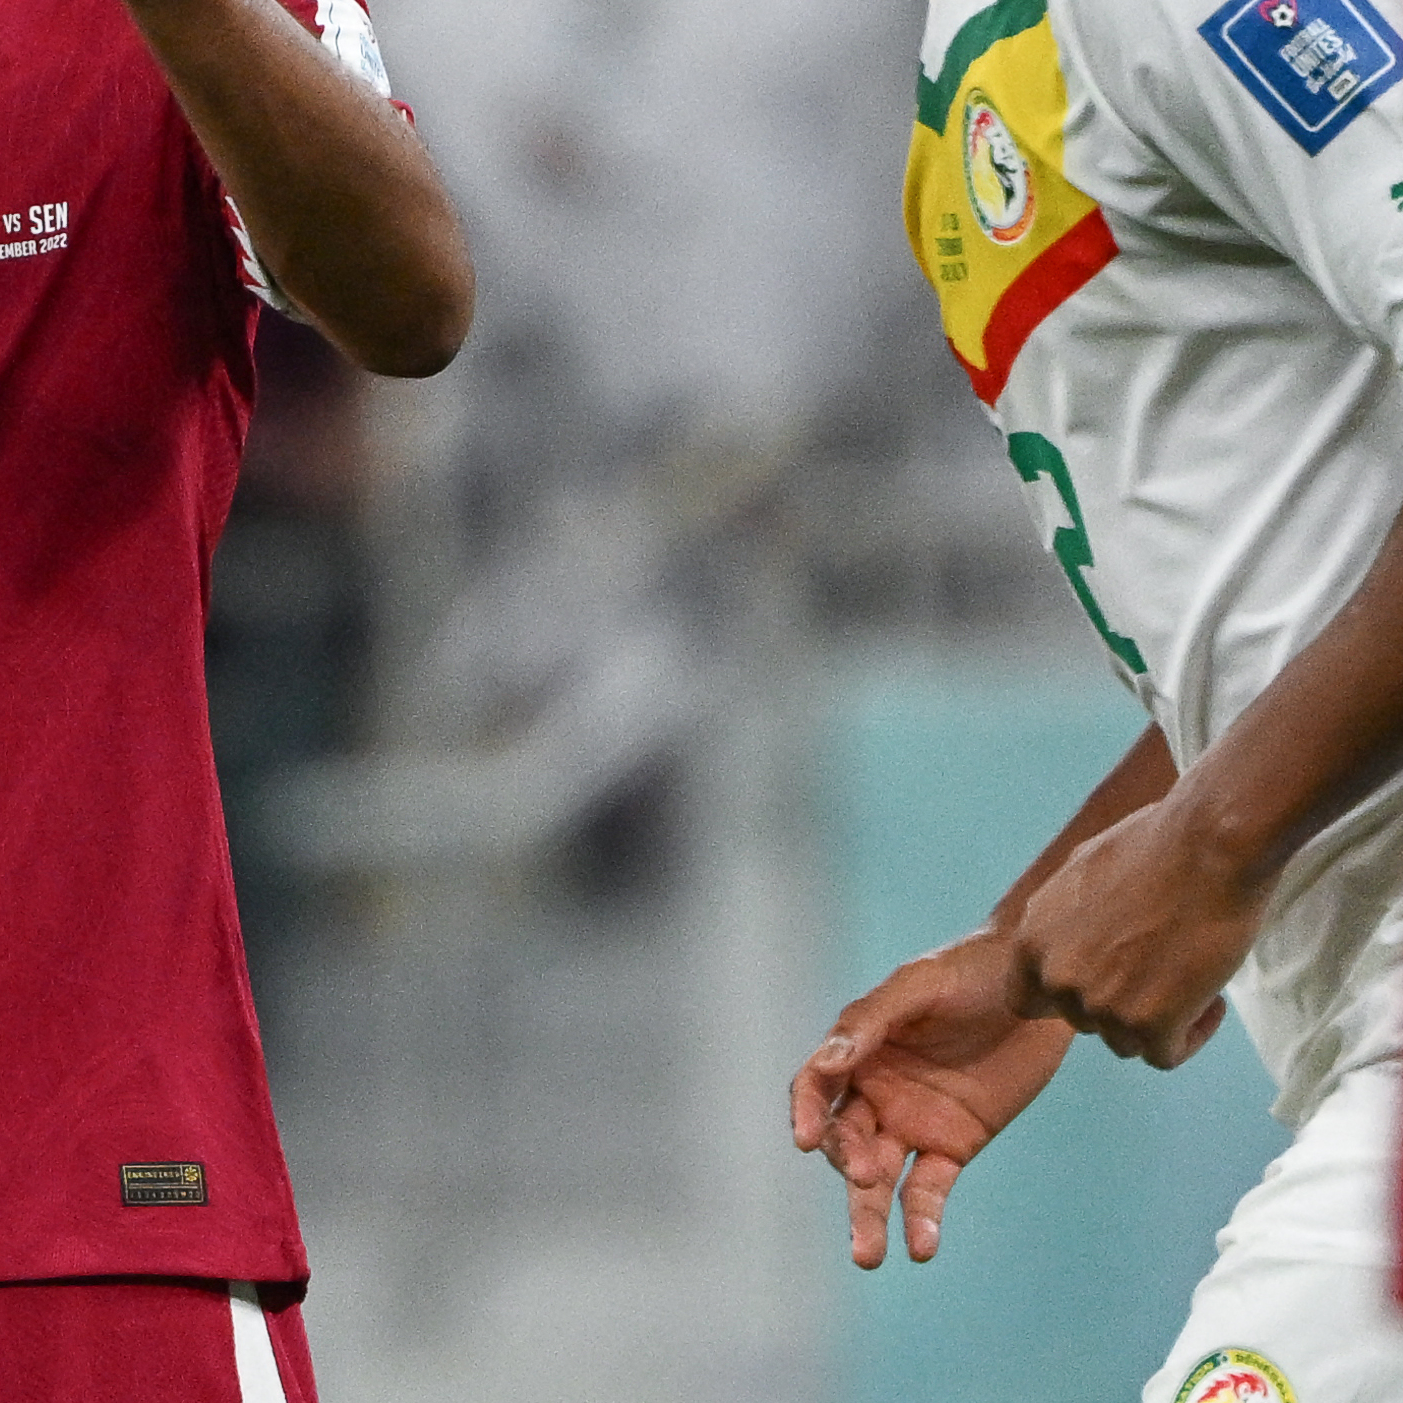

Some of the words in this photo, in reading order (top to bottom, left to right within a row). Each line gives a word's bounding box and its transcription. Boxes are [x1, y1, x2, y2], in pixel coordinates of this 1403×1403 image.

[2, 213, 21, 234] VS
[29, 201, 68, 234] SEN
[38, 232, 68, 254] 2022
